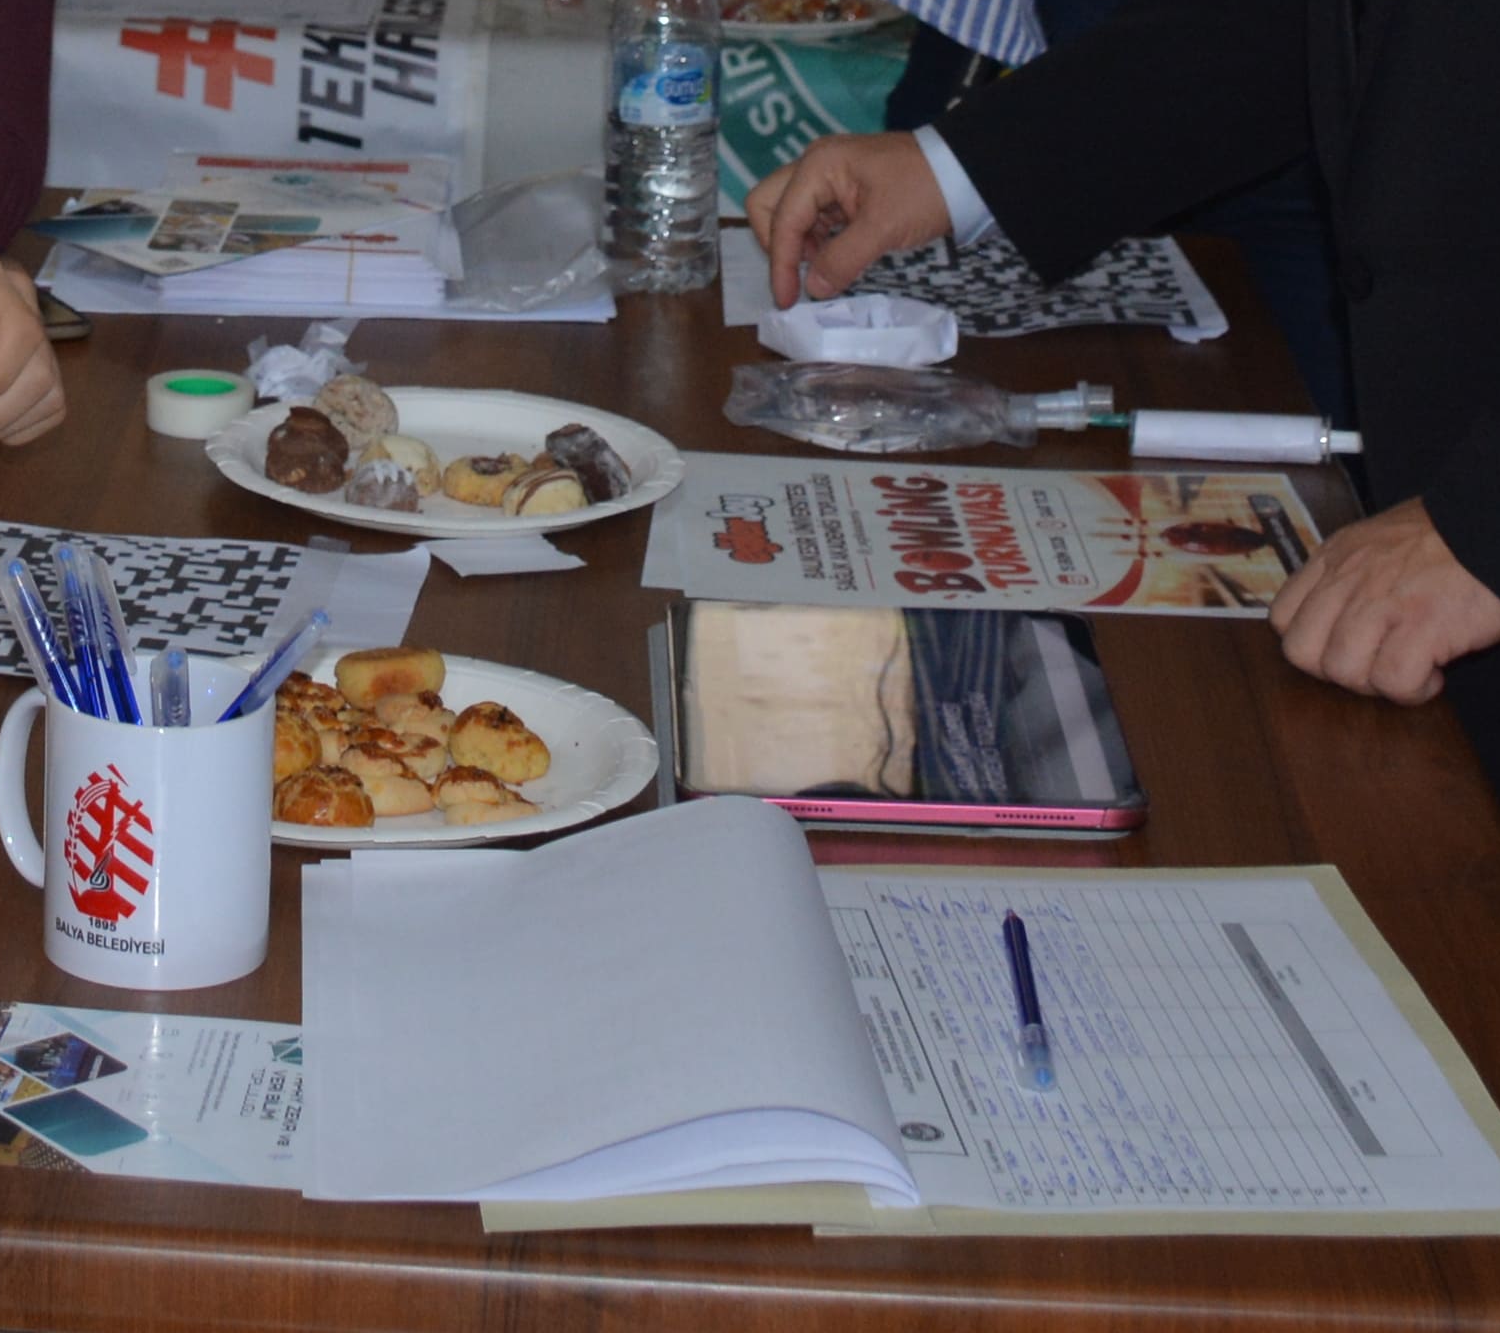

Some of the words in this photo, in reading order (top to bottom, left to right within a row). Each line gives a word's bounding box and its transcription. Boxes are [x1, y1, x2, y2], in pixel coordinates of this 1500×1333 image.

[955, 482, 1039, 590] TURNUVASI
[55, 916, 85, 943] BALYA
[86, 933, 166, 956] BELEDİYESİ
[88, 916, 118, 932] 1895
